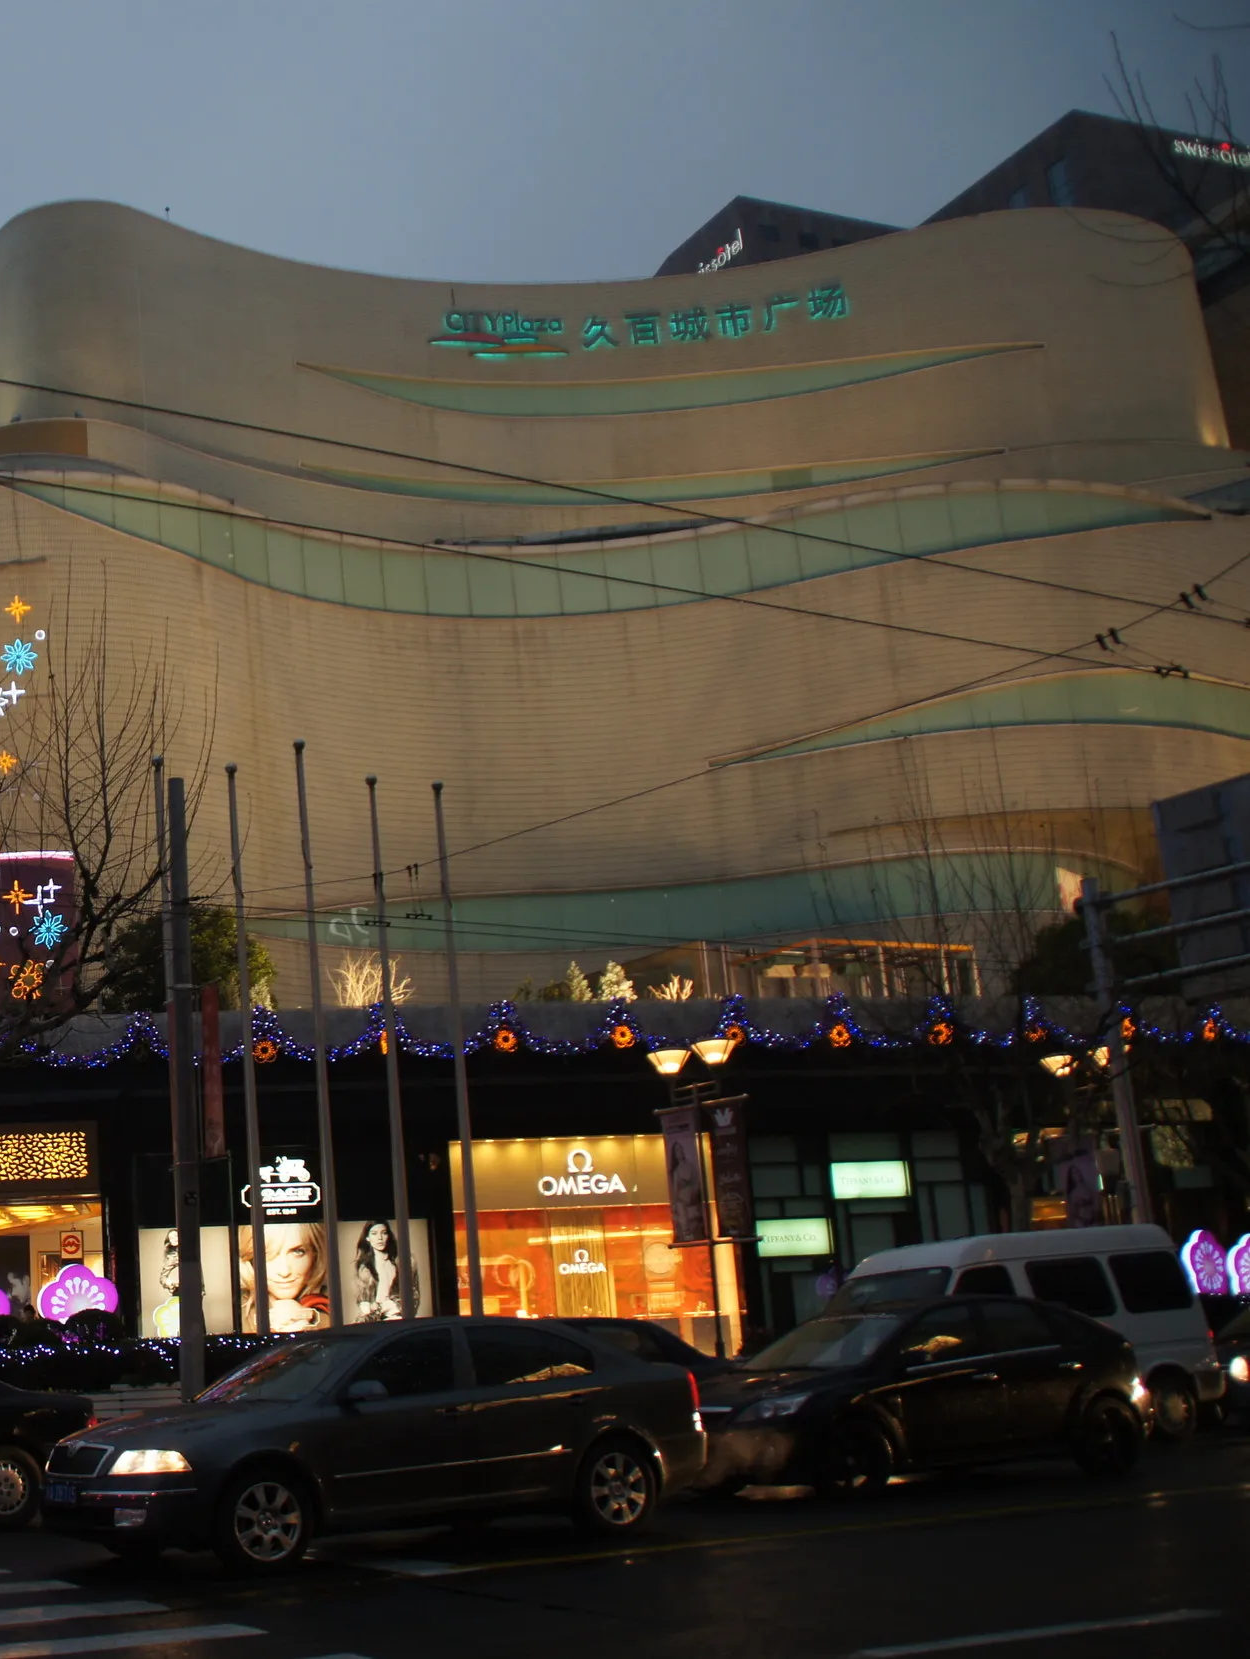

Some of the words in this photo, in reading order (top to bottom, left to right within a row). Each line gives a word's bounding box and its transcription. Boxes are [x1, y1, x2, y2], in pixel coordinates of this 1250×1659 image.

[582, 283, 849, 350] 久百城市广场
[260, 1187, 312, 1198] OACH
[537, 1173, 627, 1196] OMEGA
[559, 1262, 607, 1275] OMEGA
